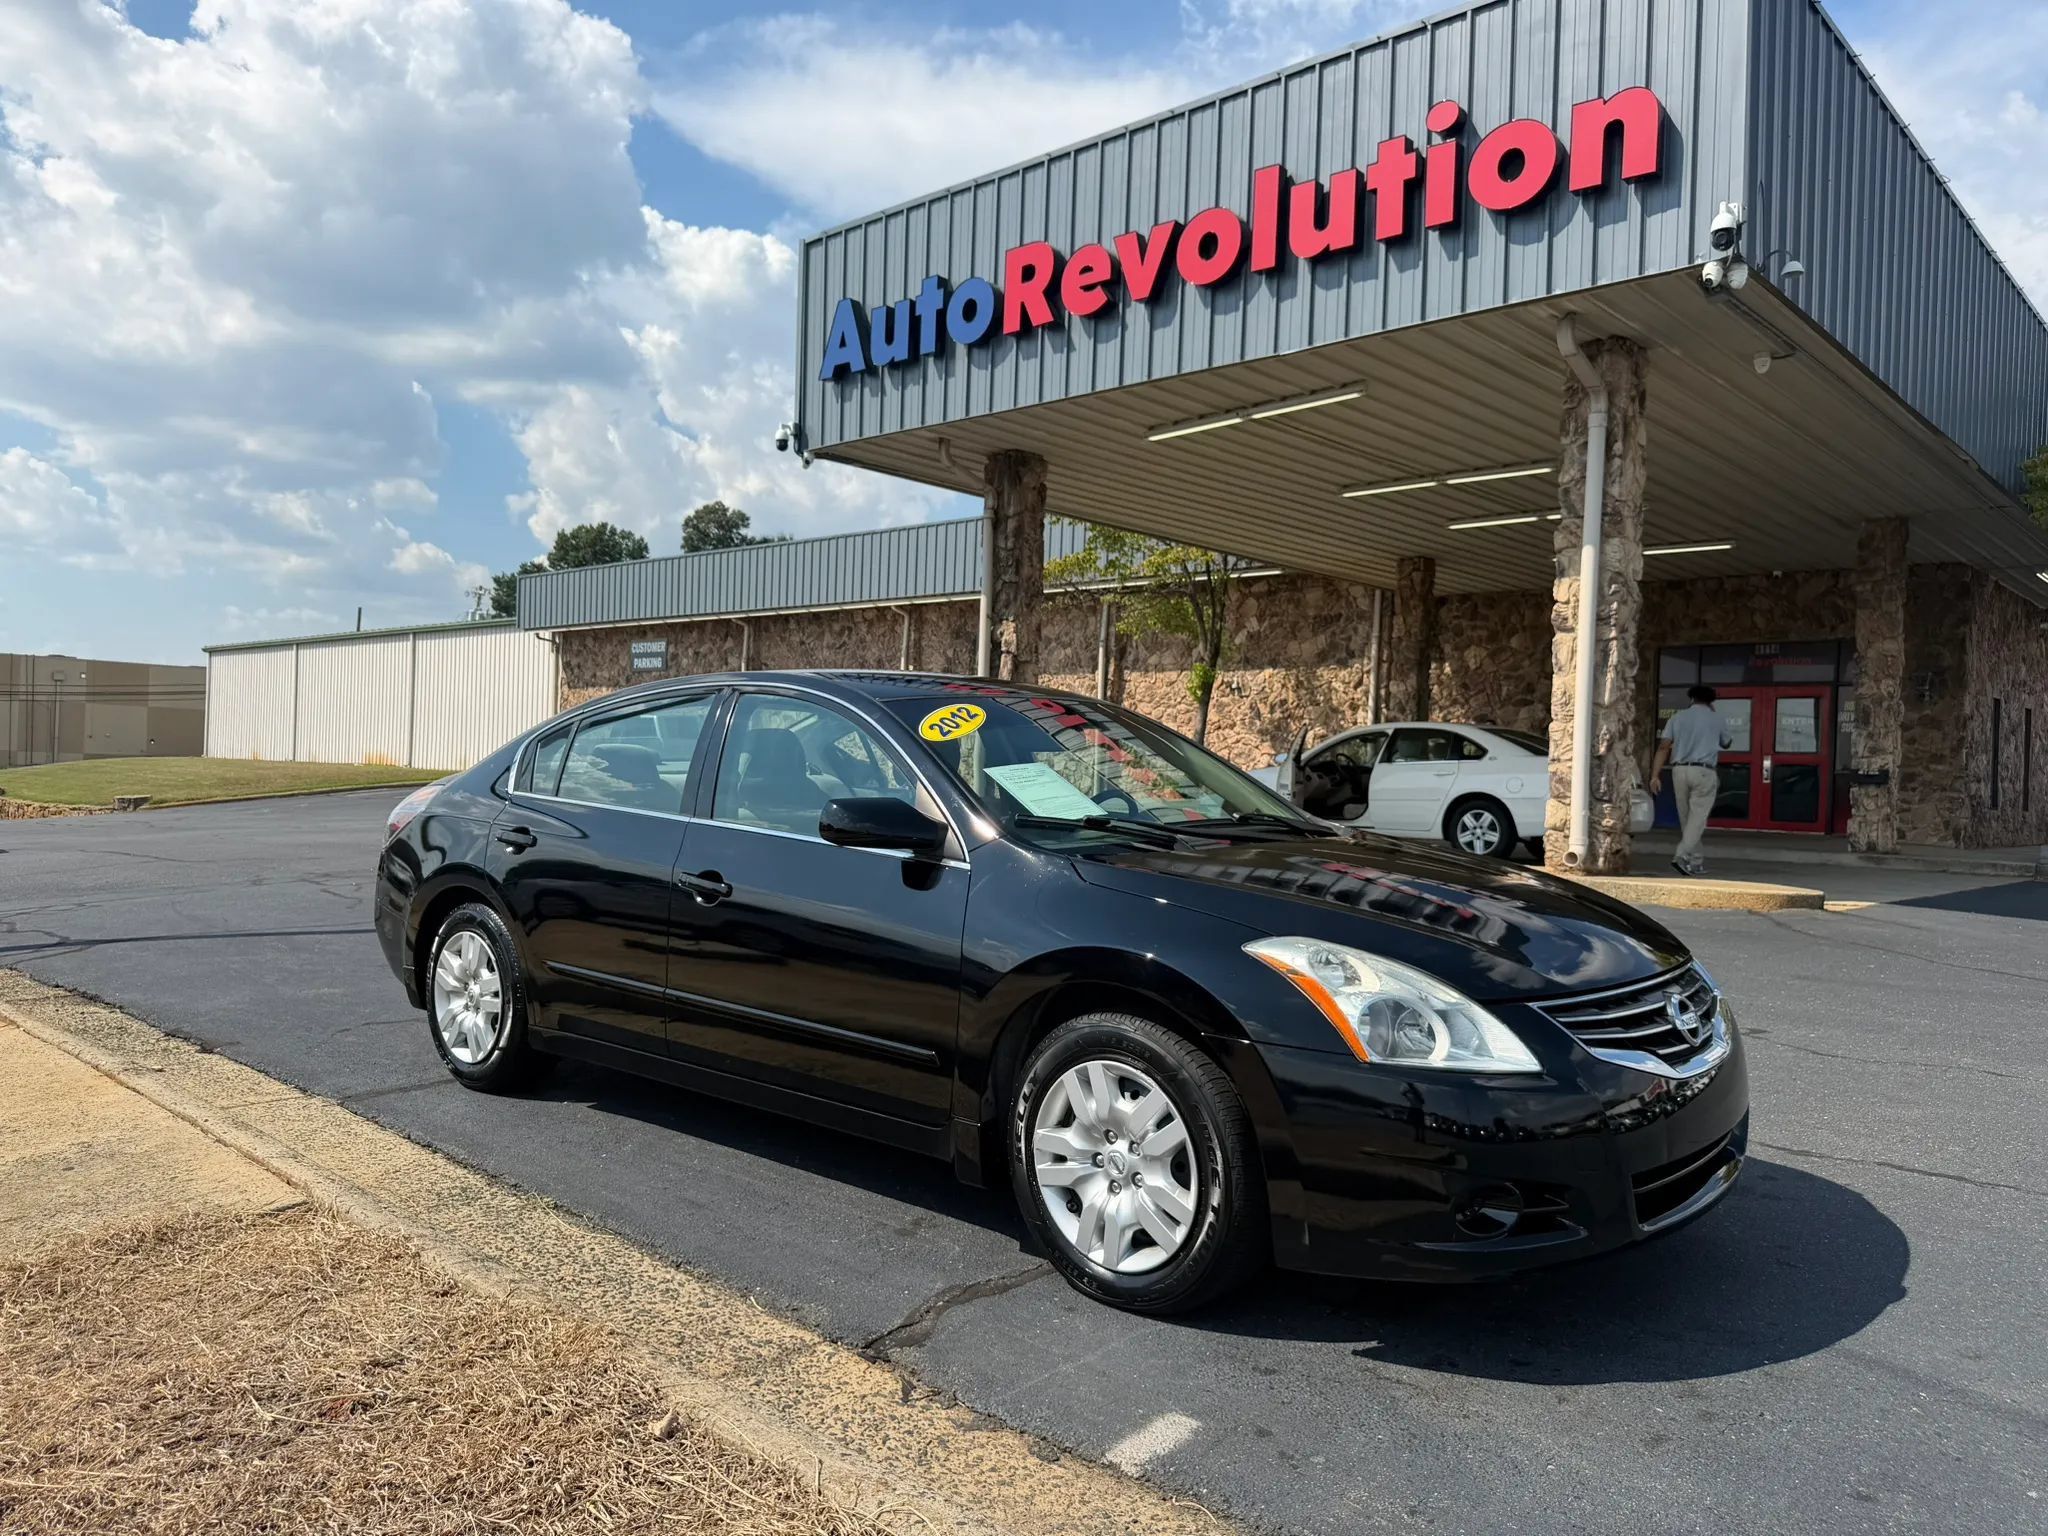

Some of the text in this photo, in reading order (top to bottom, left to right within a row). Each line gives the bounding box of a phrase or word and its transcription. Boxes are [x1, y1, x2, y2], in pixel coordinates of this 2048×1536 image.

[632, 642, 666, 653] CUSTOMER
[634, 657, 662, 668] PARKING
[929, 706, 980, 738] 2012
[1014, 1069, 1039, 1167] KELLY
